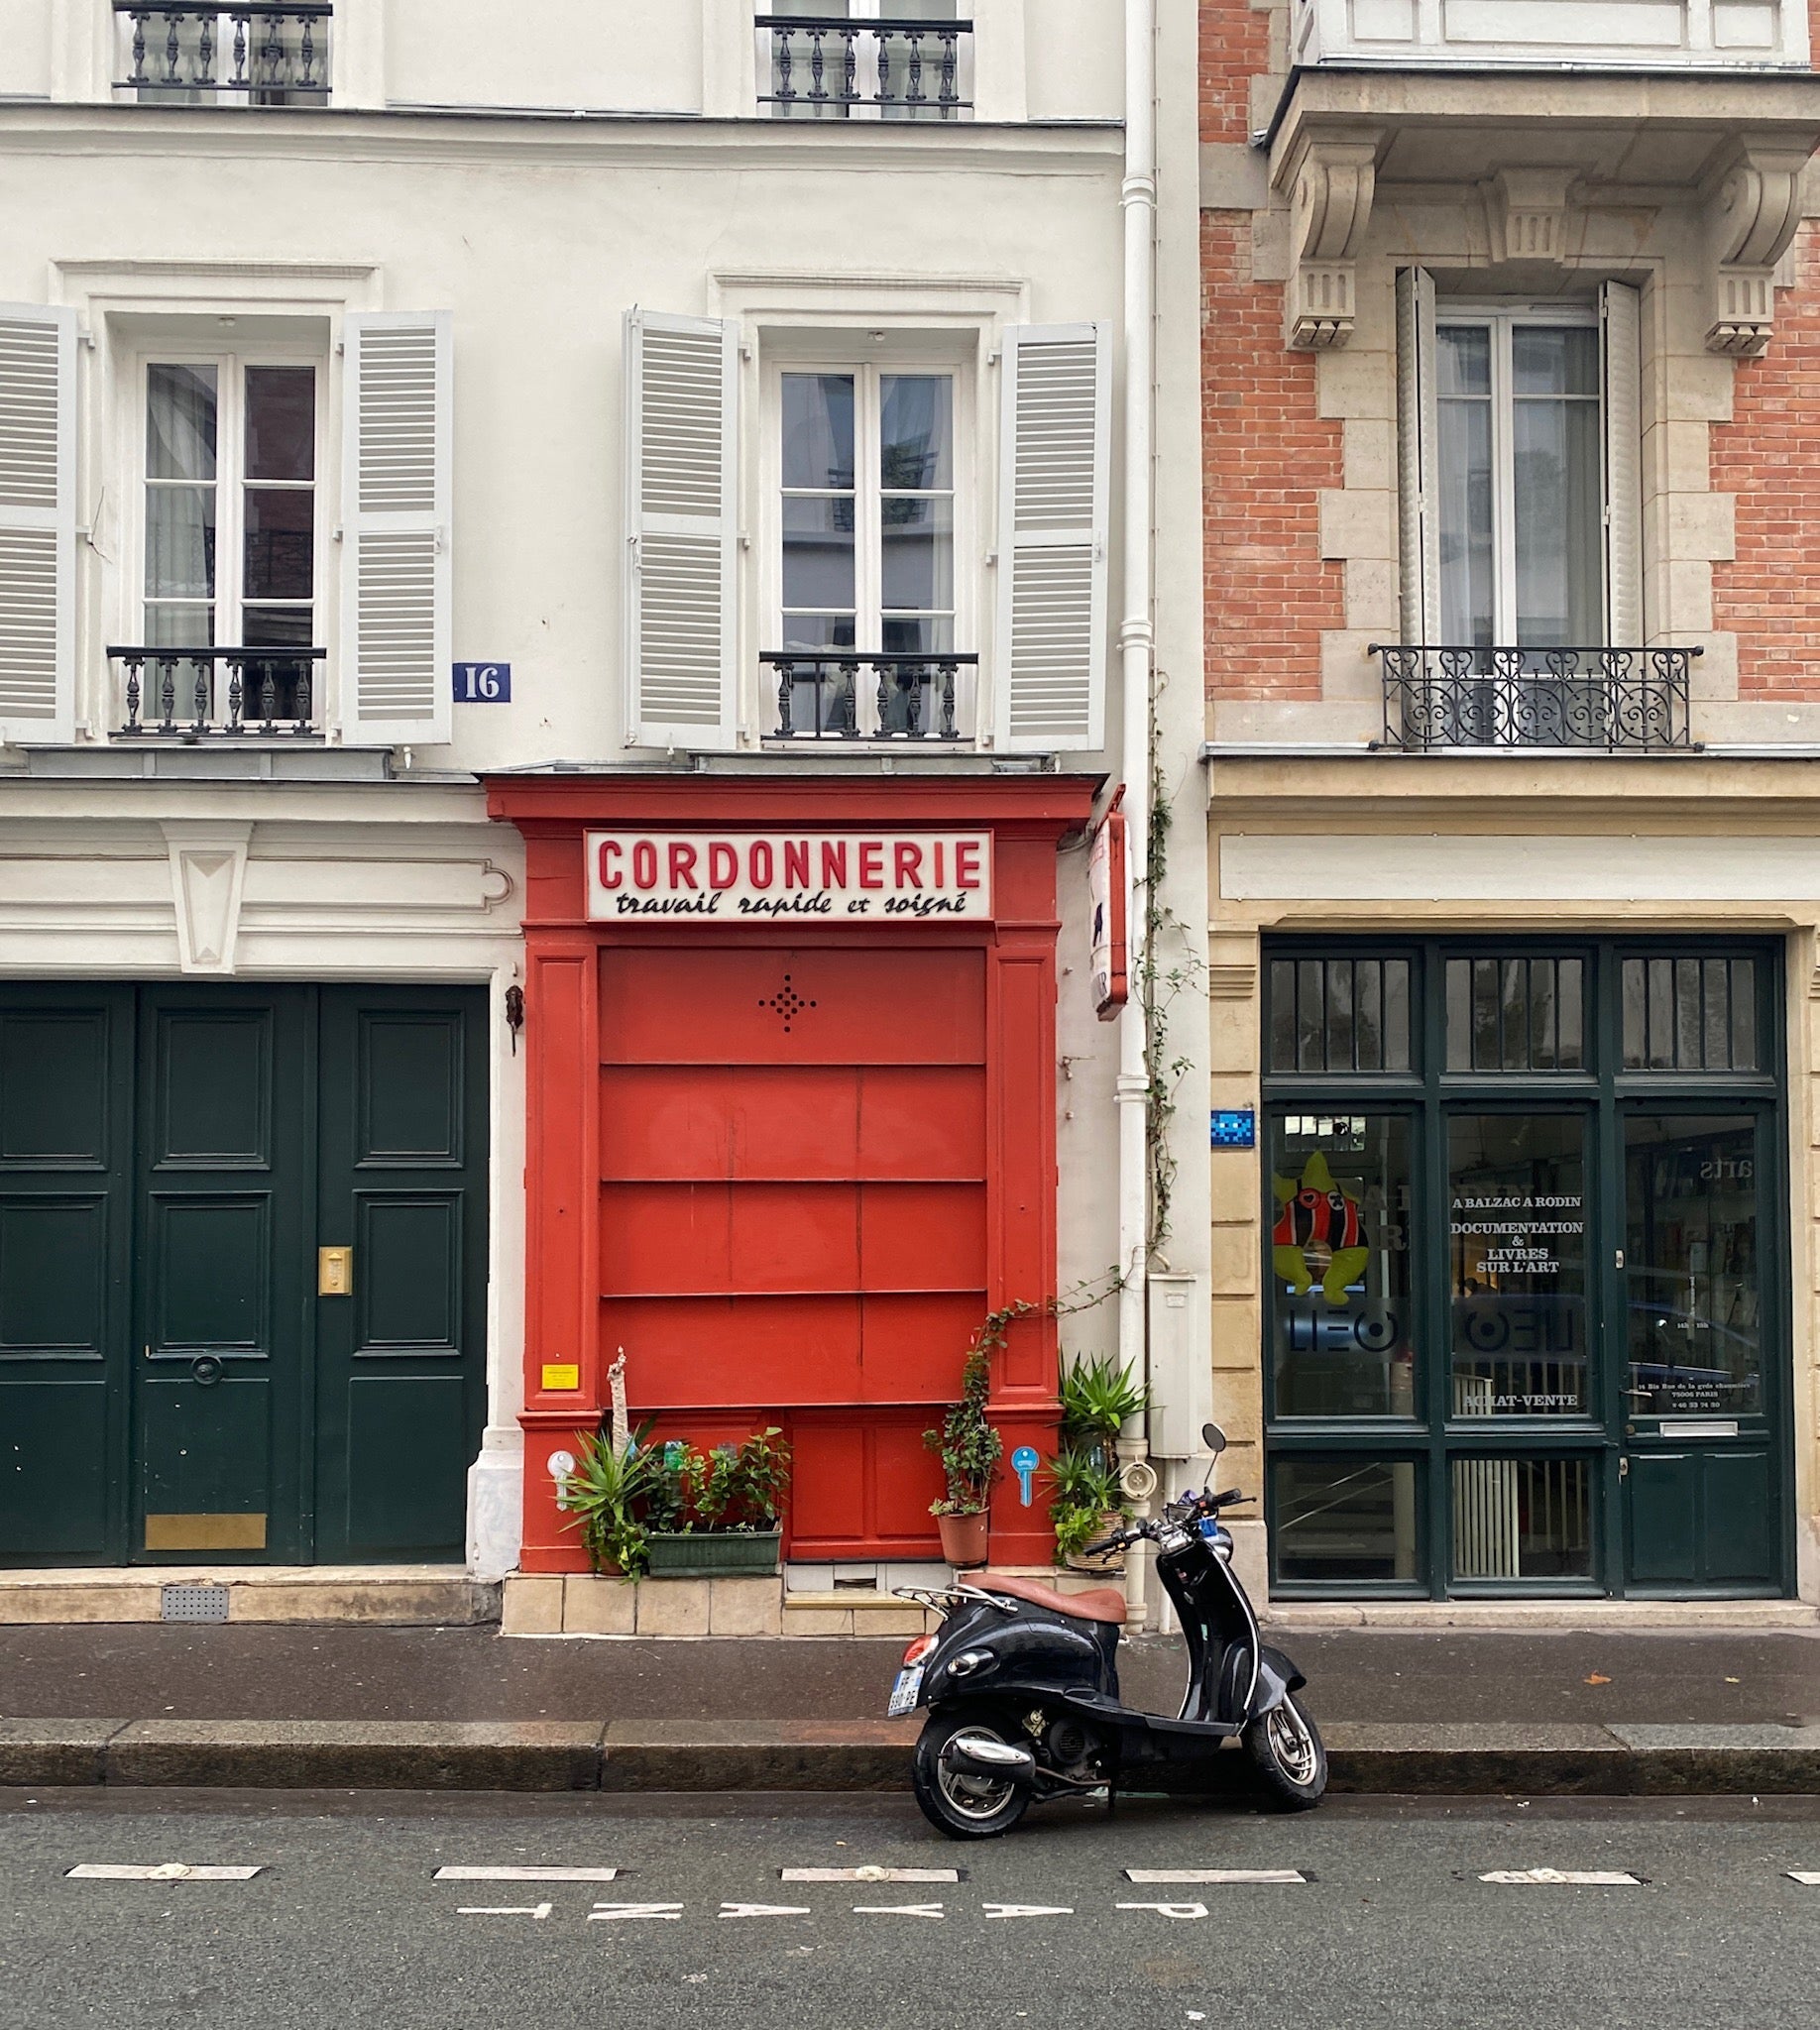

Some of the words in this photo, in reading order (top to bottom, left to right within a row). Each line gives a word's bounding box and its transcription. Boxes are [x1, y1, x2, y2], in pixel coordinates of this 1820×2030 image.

[465, 667, 500, 699] 16
[598, 840, 980, 890] CORDONNERIE
[617, 891, 723, 915] travail
[738, 890, 833, 917] rapide
[848, 897, 871, 914] et
[884, 890, 967, 917] soigné
[1452, 1197, 1463, 1209] A
[1464, 1196, 1522, 1209] BALZAC
[1523, 1196, 1534, 1208] A
[1535, 1195, 1582, 1208] RODIN
[1450, 1221, 1584, 1235] DOCUMENTATION
[1512, 1235, 1525, 1247] &
[1487, 1247, 1549, 1261] LIVRES
[1476, 1261, 1511, 1274] SUR
[1512, 1261, 1560, 1274] L'ART
